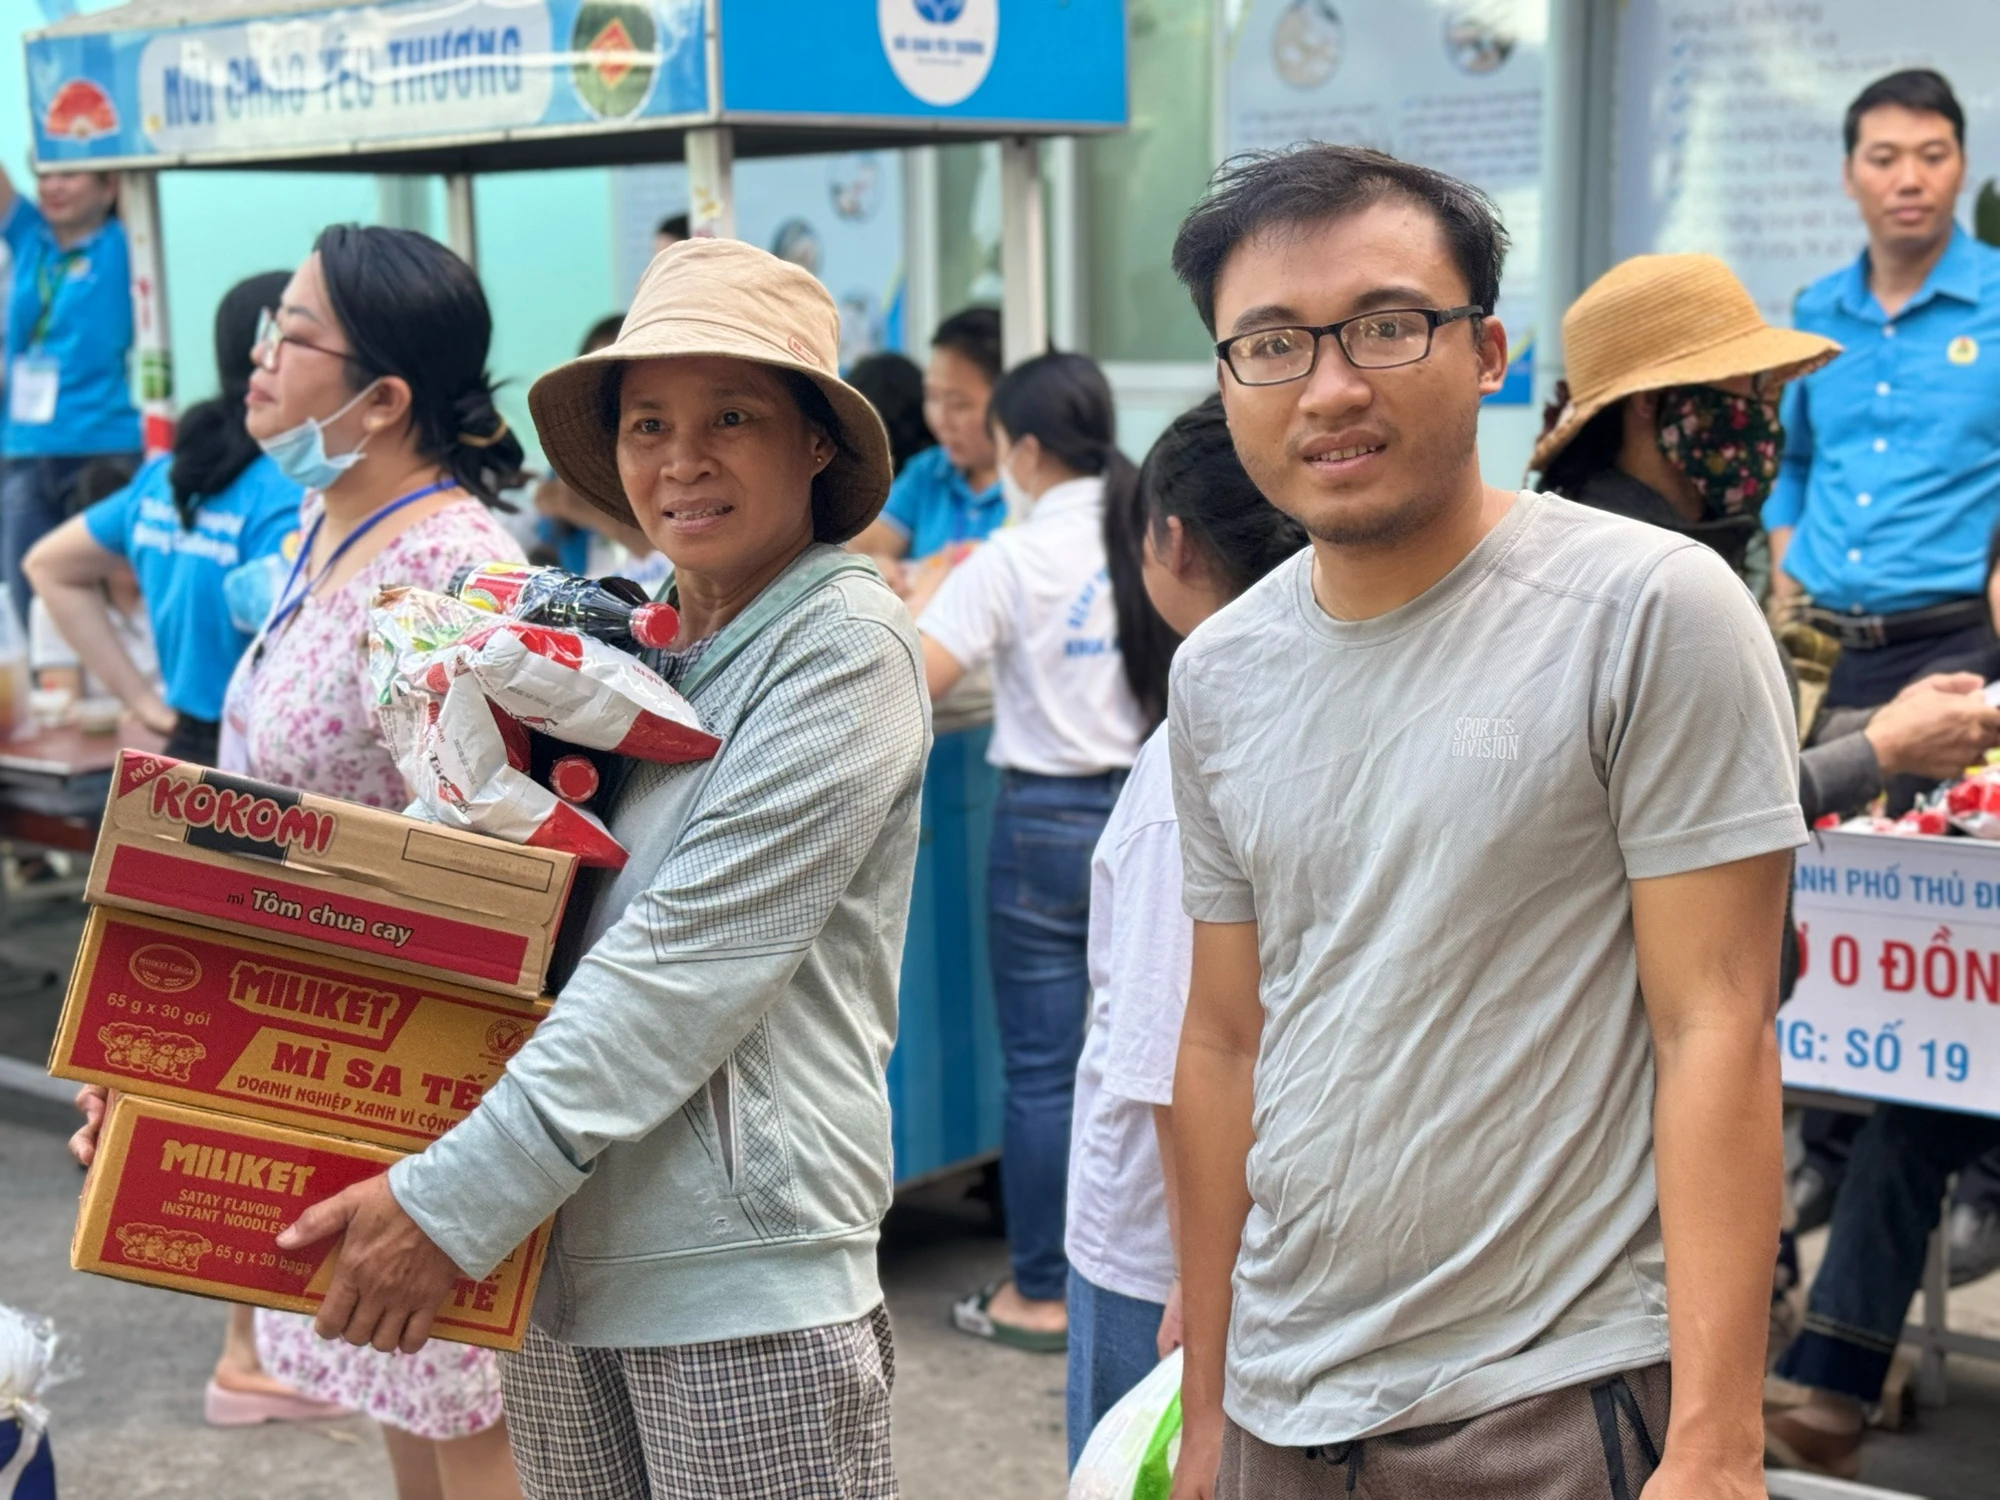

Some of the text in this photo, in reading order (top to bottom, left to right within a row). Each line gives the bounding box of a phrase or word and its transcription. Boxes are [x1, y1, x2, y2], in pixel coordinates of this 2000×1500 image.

[387, 26, 522, 106] THƯƠNG
[1451, 734, 1520, 761] DIVISION
[1453, 716, 1516, 741] SPORTS
[150, 775, 337, 857] KOKOMI
[1846, 863, 1901, 900] PHỐ
[1909, 869, 1965, 907] THỦ
[1973, 881, 2000, 909] Đ
[225, 889, 414, 948] mì Tôm chua cay
[107, 992, 211, 1026] 65 g x 30 gói
[231, 963, 400, 1035] MILIKET
[1844, 1019, 1904, 1074] SỐ
[1919, 1038, 1970, 1083] 19
[236, 1074, 293, 1098] DOANH
[297, 1086, 352, 1112] NGHIỆP
[354, 1099, 397, 1122] XANH
[400, 1108, 416, 1125] VÌ
[270, 1042, 487, 1112] MÌ SA TẾ
[159, 1139, 317, 1198] MILIKET
[160, 1201, 289, 1234] INSTANT NOODLES
[179, 1188, 283, 1219] SATAY FLAVOUR
[215, 1244, 312, 1275] 65 g x 30 bags
